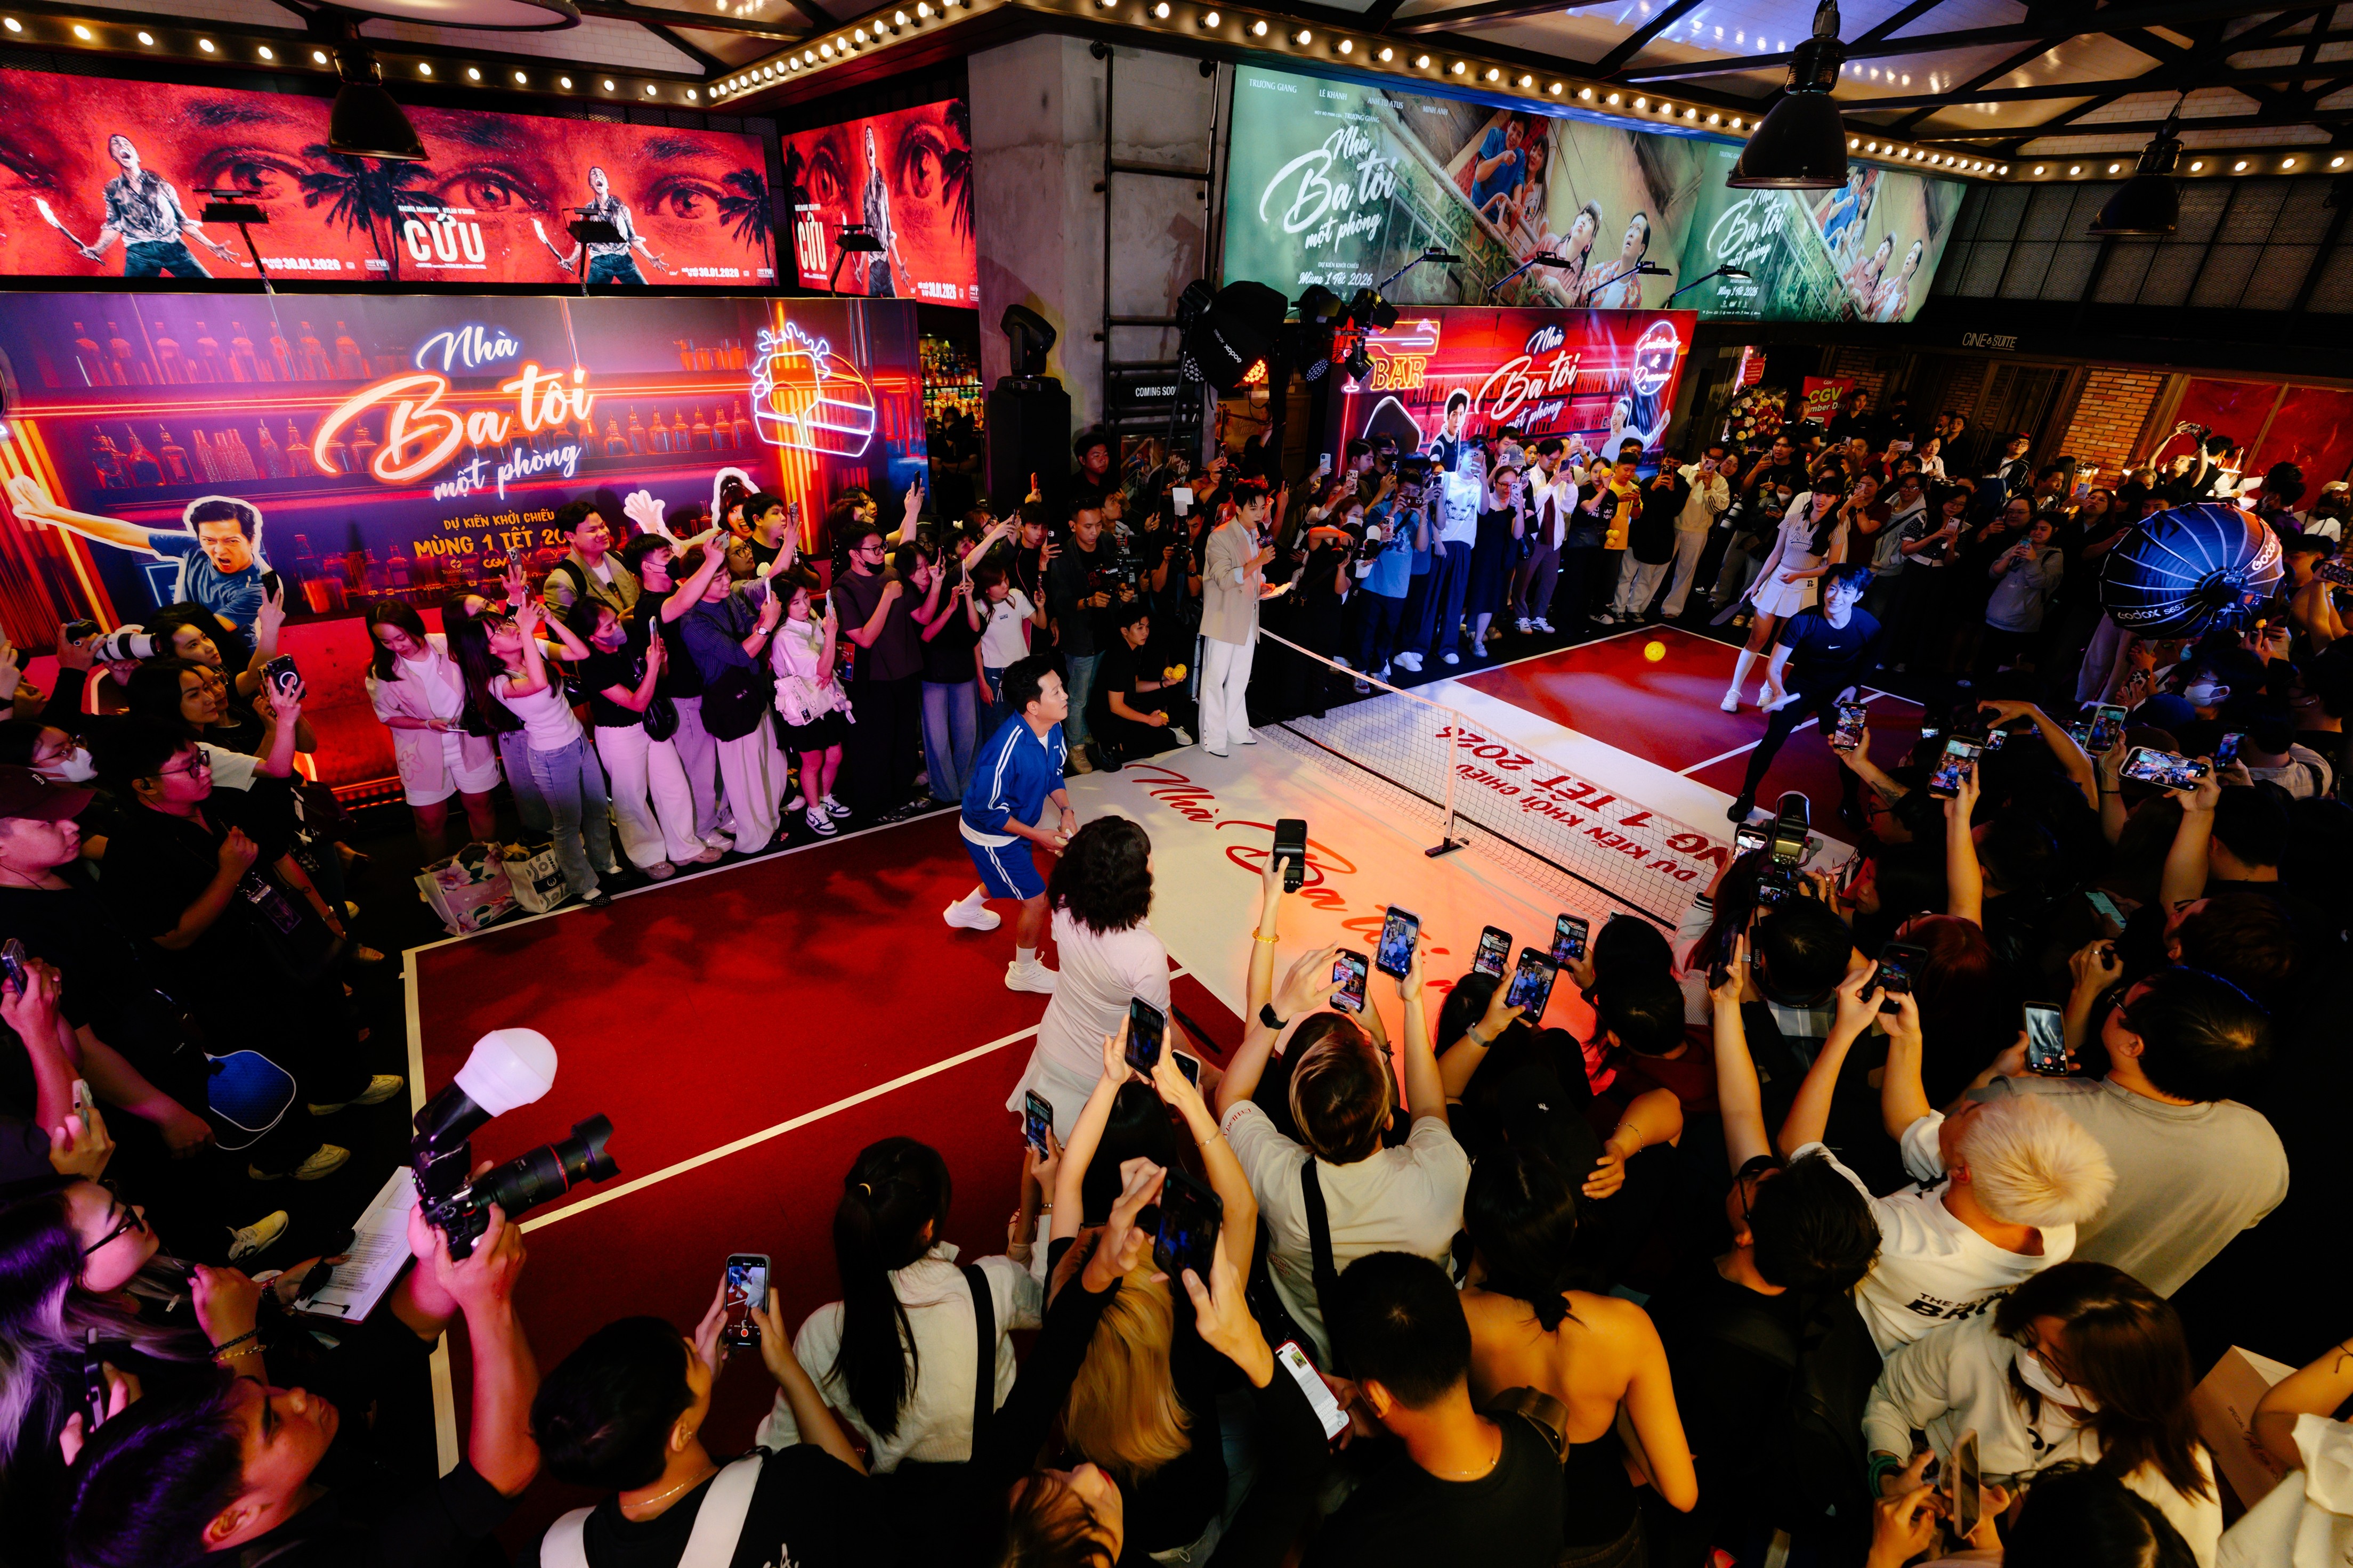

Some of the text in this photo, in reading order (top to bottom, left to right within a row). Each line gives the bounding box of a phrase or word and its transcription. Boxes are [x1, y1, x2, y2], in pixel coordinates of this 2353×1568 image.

[1249, 78, 1297, 93] TRƯỜNG GIANG
[1319, 89, 1347, 101] LÊ KHÁNH
[1345, 112, 1364, 121] TRƯỜNG
[1368, 97, 1380, 105] ANH
[1389, 101, 1403, 110] ATUS
[1422, 105, 1436, 114] MINH
[1322, 125, 1371, 160] Nhà
[1259, 149, 1398, 234] Ba tôi
[403, 213, 486, 262] CỨU
[797, 211, 827, 272] CỨU
[1305, 211, 1382, 254] một phòng
[1707, 197, 1788, 259] Ba tôi
[282, 258, 341, 271] 30.01.2026
[1741, 242, 1772, 271] phòng
[698, 267, 739, 278] 30.01.2026
[1324, 272, 1332, 285] 1
[1332, 272, 1346, 285] Tết
[1348, 273, 1373, 286] 2026
[928, 281, 956, 299] 30.01.2026
[1731, 286, 1737, 296] 1
[1743, 286, 1759, 296] 2026
[416, 326, 518, 372] Nhà
[1224, 344, 1242, 363] Godox
[1526, 326, 1565, 355] Nhà
[1370, 355, 1427, 392] BAR
[1474, 350, 1581, 420] Ba tôi
[1135, 386, 1177, 396] COMING SOO
[1808, 386, 1843, 404] CGV
[1529, 398, 1565, 435] phòng
[1809, 402, 1846, 412] mber Day
[314, 364, 595, 480] Ba tôi
[433, 443, 582, 501] một phòng
[443, 508, 555, 531] DỰ KIẾN KHỞI CHIẾU
[414, 525, 567, 558] MÙNG 1 TẾT 20
[2164, 602, 2186, 614] S65T
[1124, 764, 1220, 823] Nhà
[1531, 775, 1617, 813] TẾT
[1456, 764, 1697, 882] DỰ KIẾN KHỞI CHIẾU
[1619, 811, 1653, 828] 1
[1216, 820, 1357, 912] Ba
[1666, 833, 1728, 870] NG
[1920, 1293, 1953, 1307] THE
